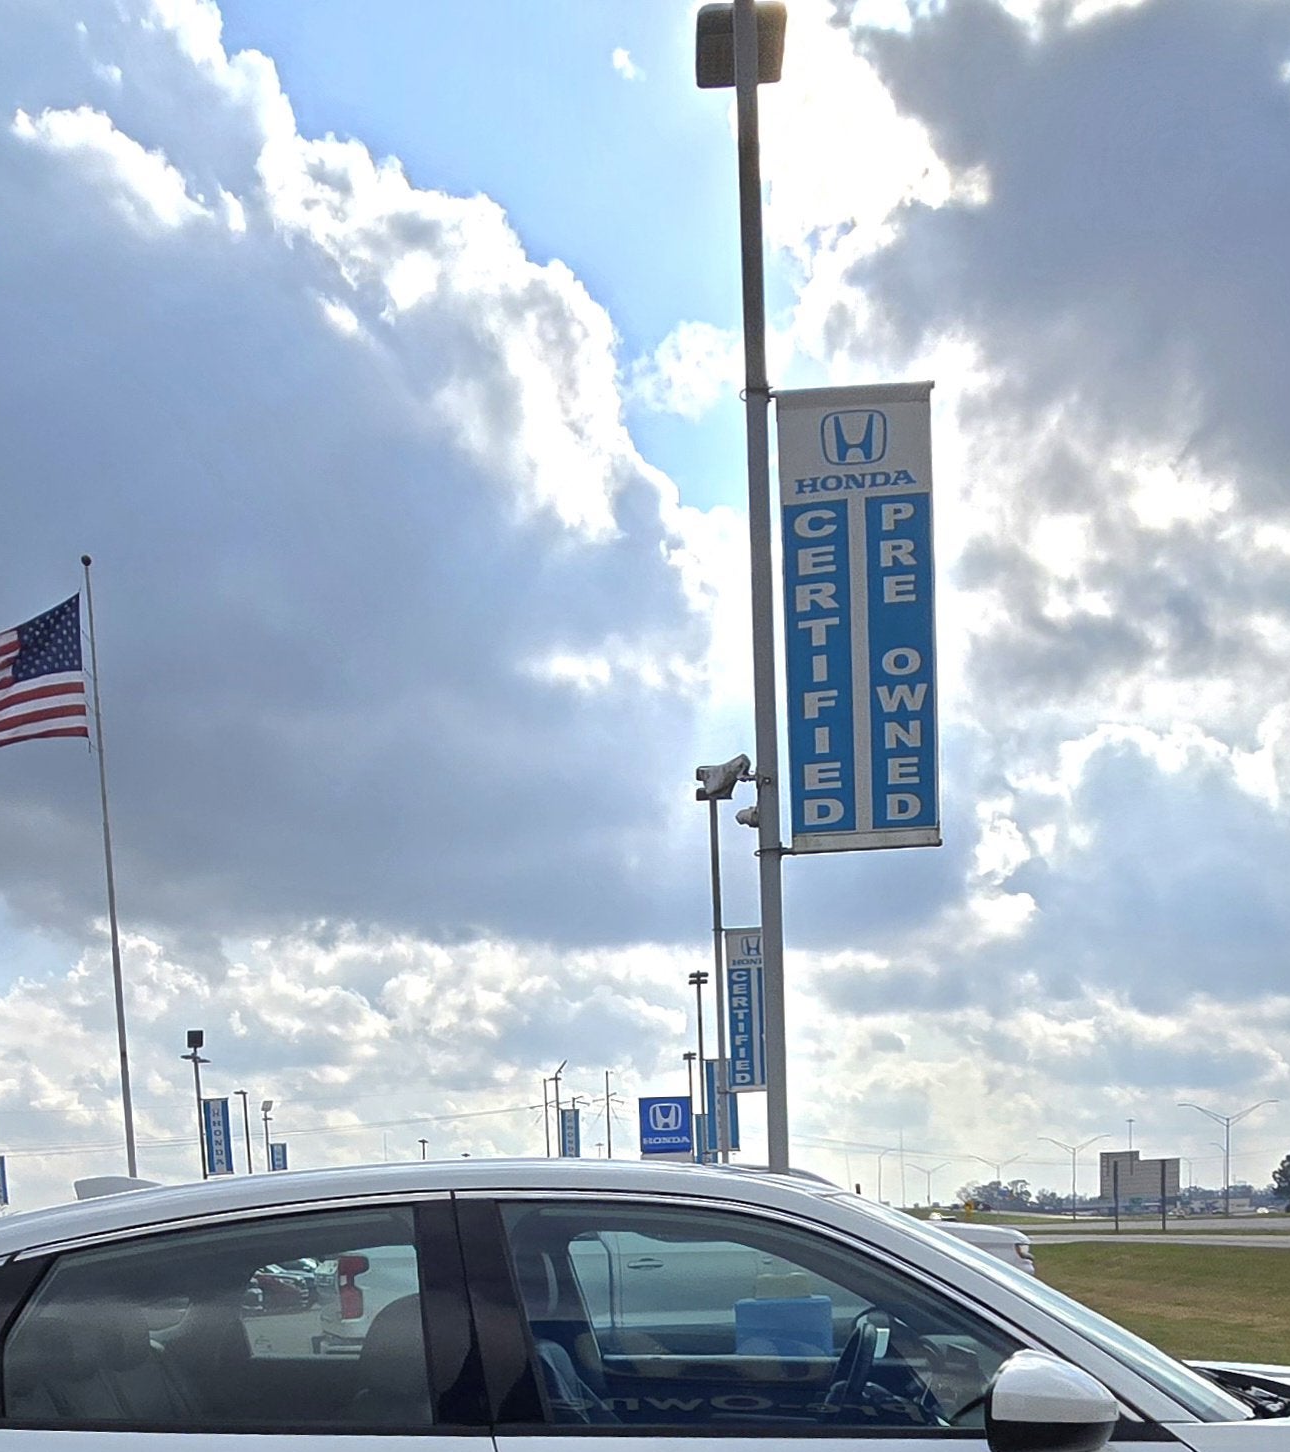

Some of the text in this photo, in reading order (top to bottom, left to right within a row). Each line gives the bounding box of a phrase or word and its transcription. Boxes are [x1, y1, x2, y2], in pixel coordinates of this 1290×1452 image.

[794, 468, 917, 494] HONDA
[792, 508, 845, 827] CERTIFIED
[876, 501, 928, 822] PRE OWNED
[730, 969, 752, 1085] CERTIFIED
[212, 1120, 225, 1166] HONDA
[642, 1135, 691, 1145] HONDA
